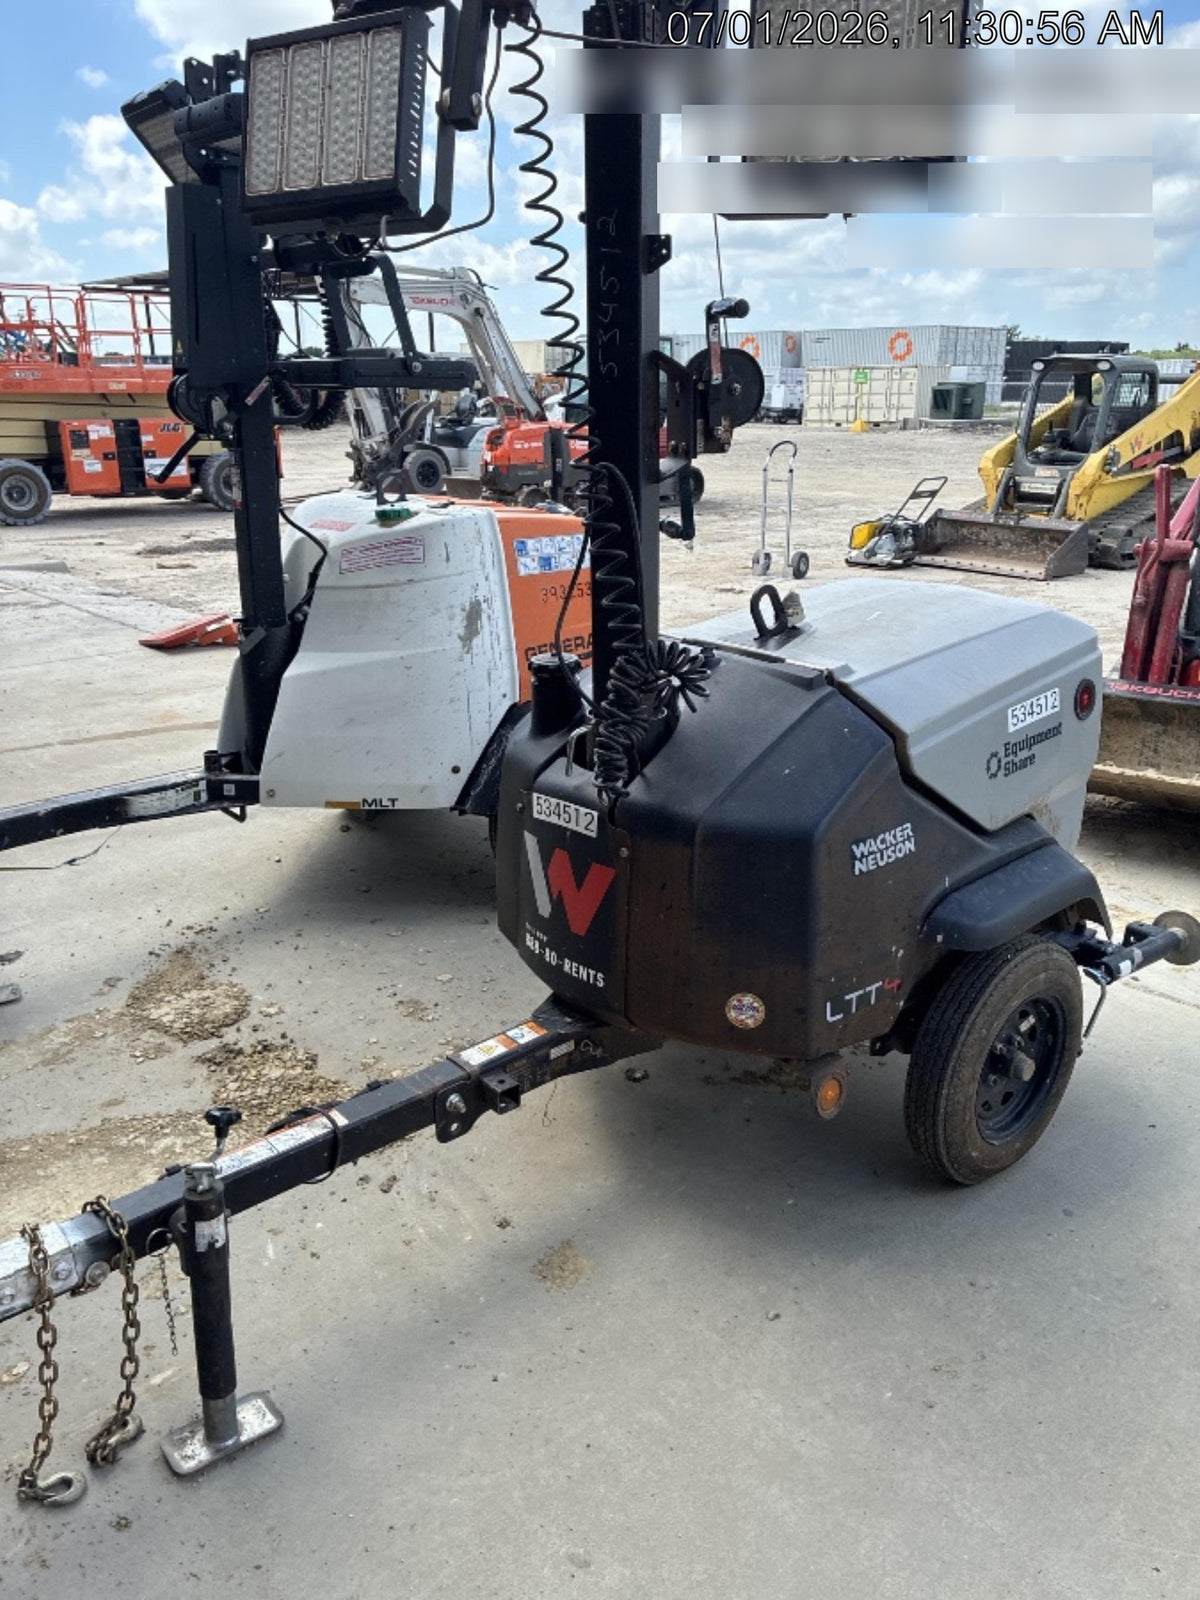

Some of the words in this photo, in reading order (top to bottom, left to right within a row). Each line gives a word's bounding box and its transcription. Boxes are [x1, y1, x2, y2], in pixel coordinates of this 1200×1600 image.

[596, 207, 622, 378] 534512
[160, 422, 182, 433] JLG
[541, 582, 592, 603] 39353
[1010, 690, 1059, 728] 534512
[1003, 722, 1063, 758] Equipment
[1003, 753, 1036, 777] Share
[362, 797, 399, 808] MLT
[536, 796, 595, 833] 534512
[851, 822, 915, 859] WACKER
[854, 837, 916, 876] NEUSON
